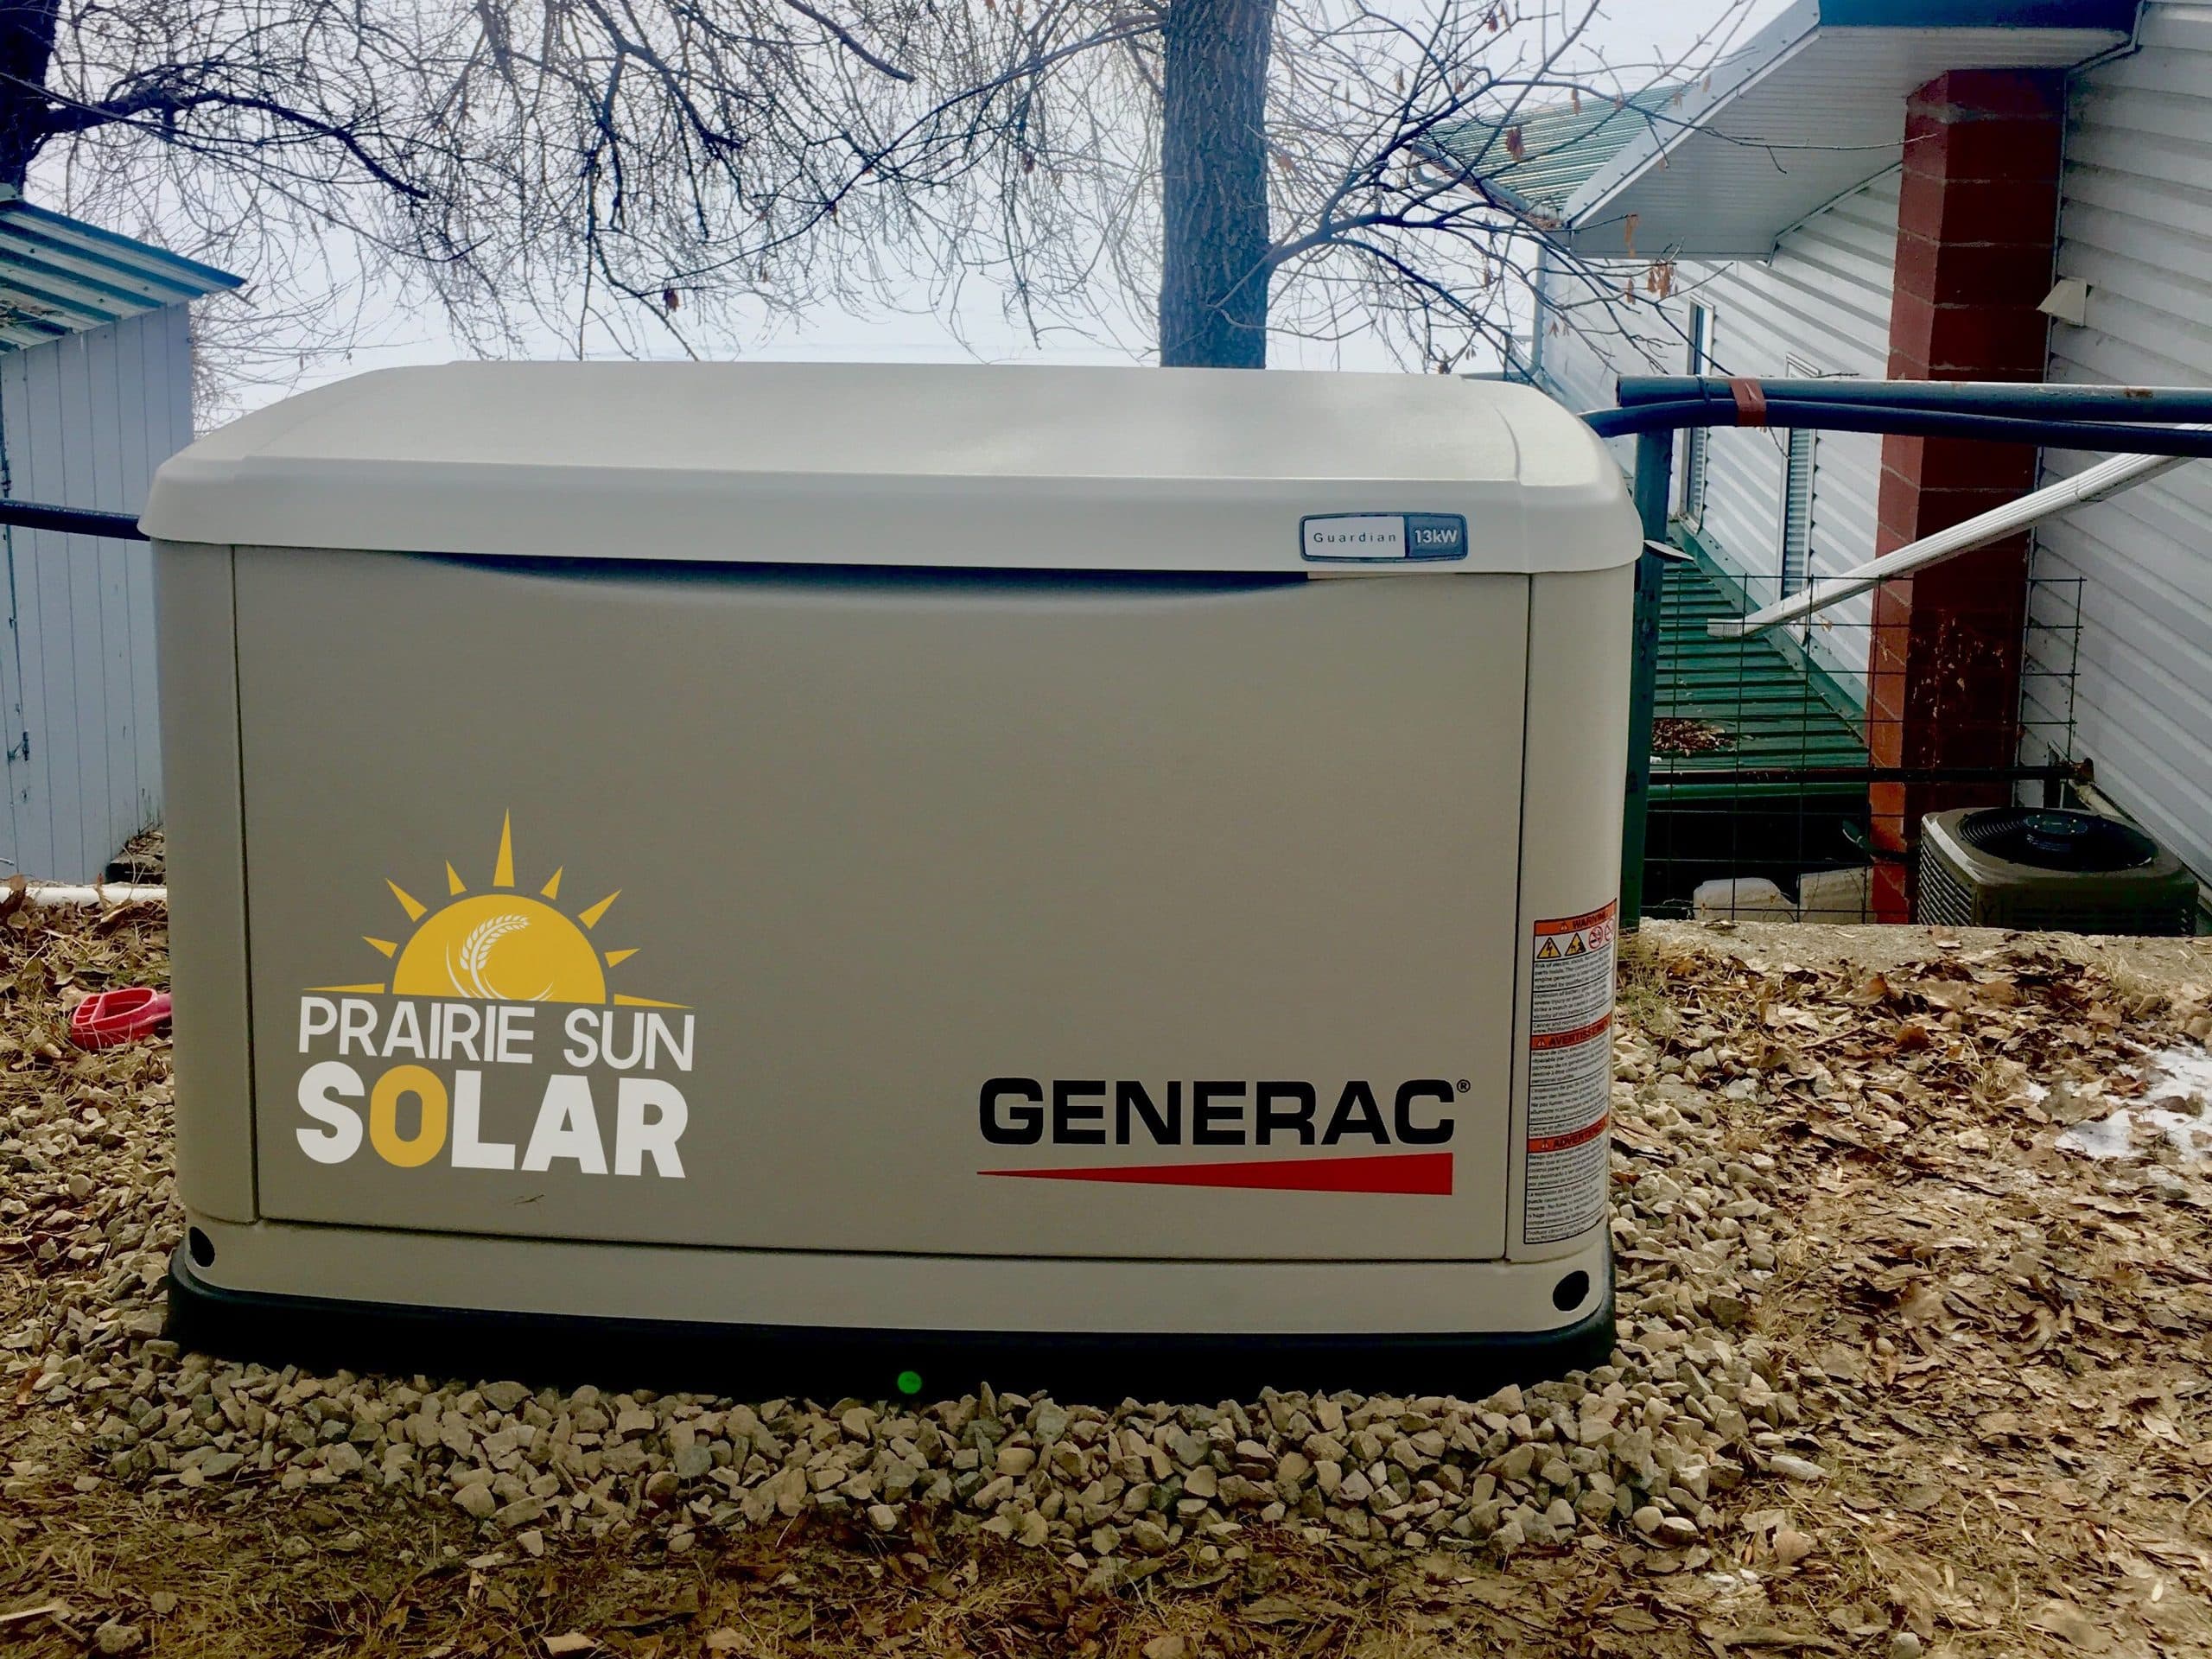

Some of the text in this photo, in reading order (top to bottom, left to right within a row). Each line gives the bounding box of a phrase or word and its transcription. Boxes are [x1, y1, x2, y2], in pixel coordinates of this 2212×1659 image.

[1313, 529, 1458, 543] Guardian 13kW
[299, 996, 695, 1071] PRAIRIE SUN
[296, 1061, 689, 1178] SOLAR
